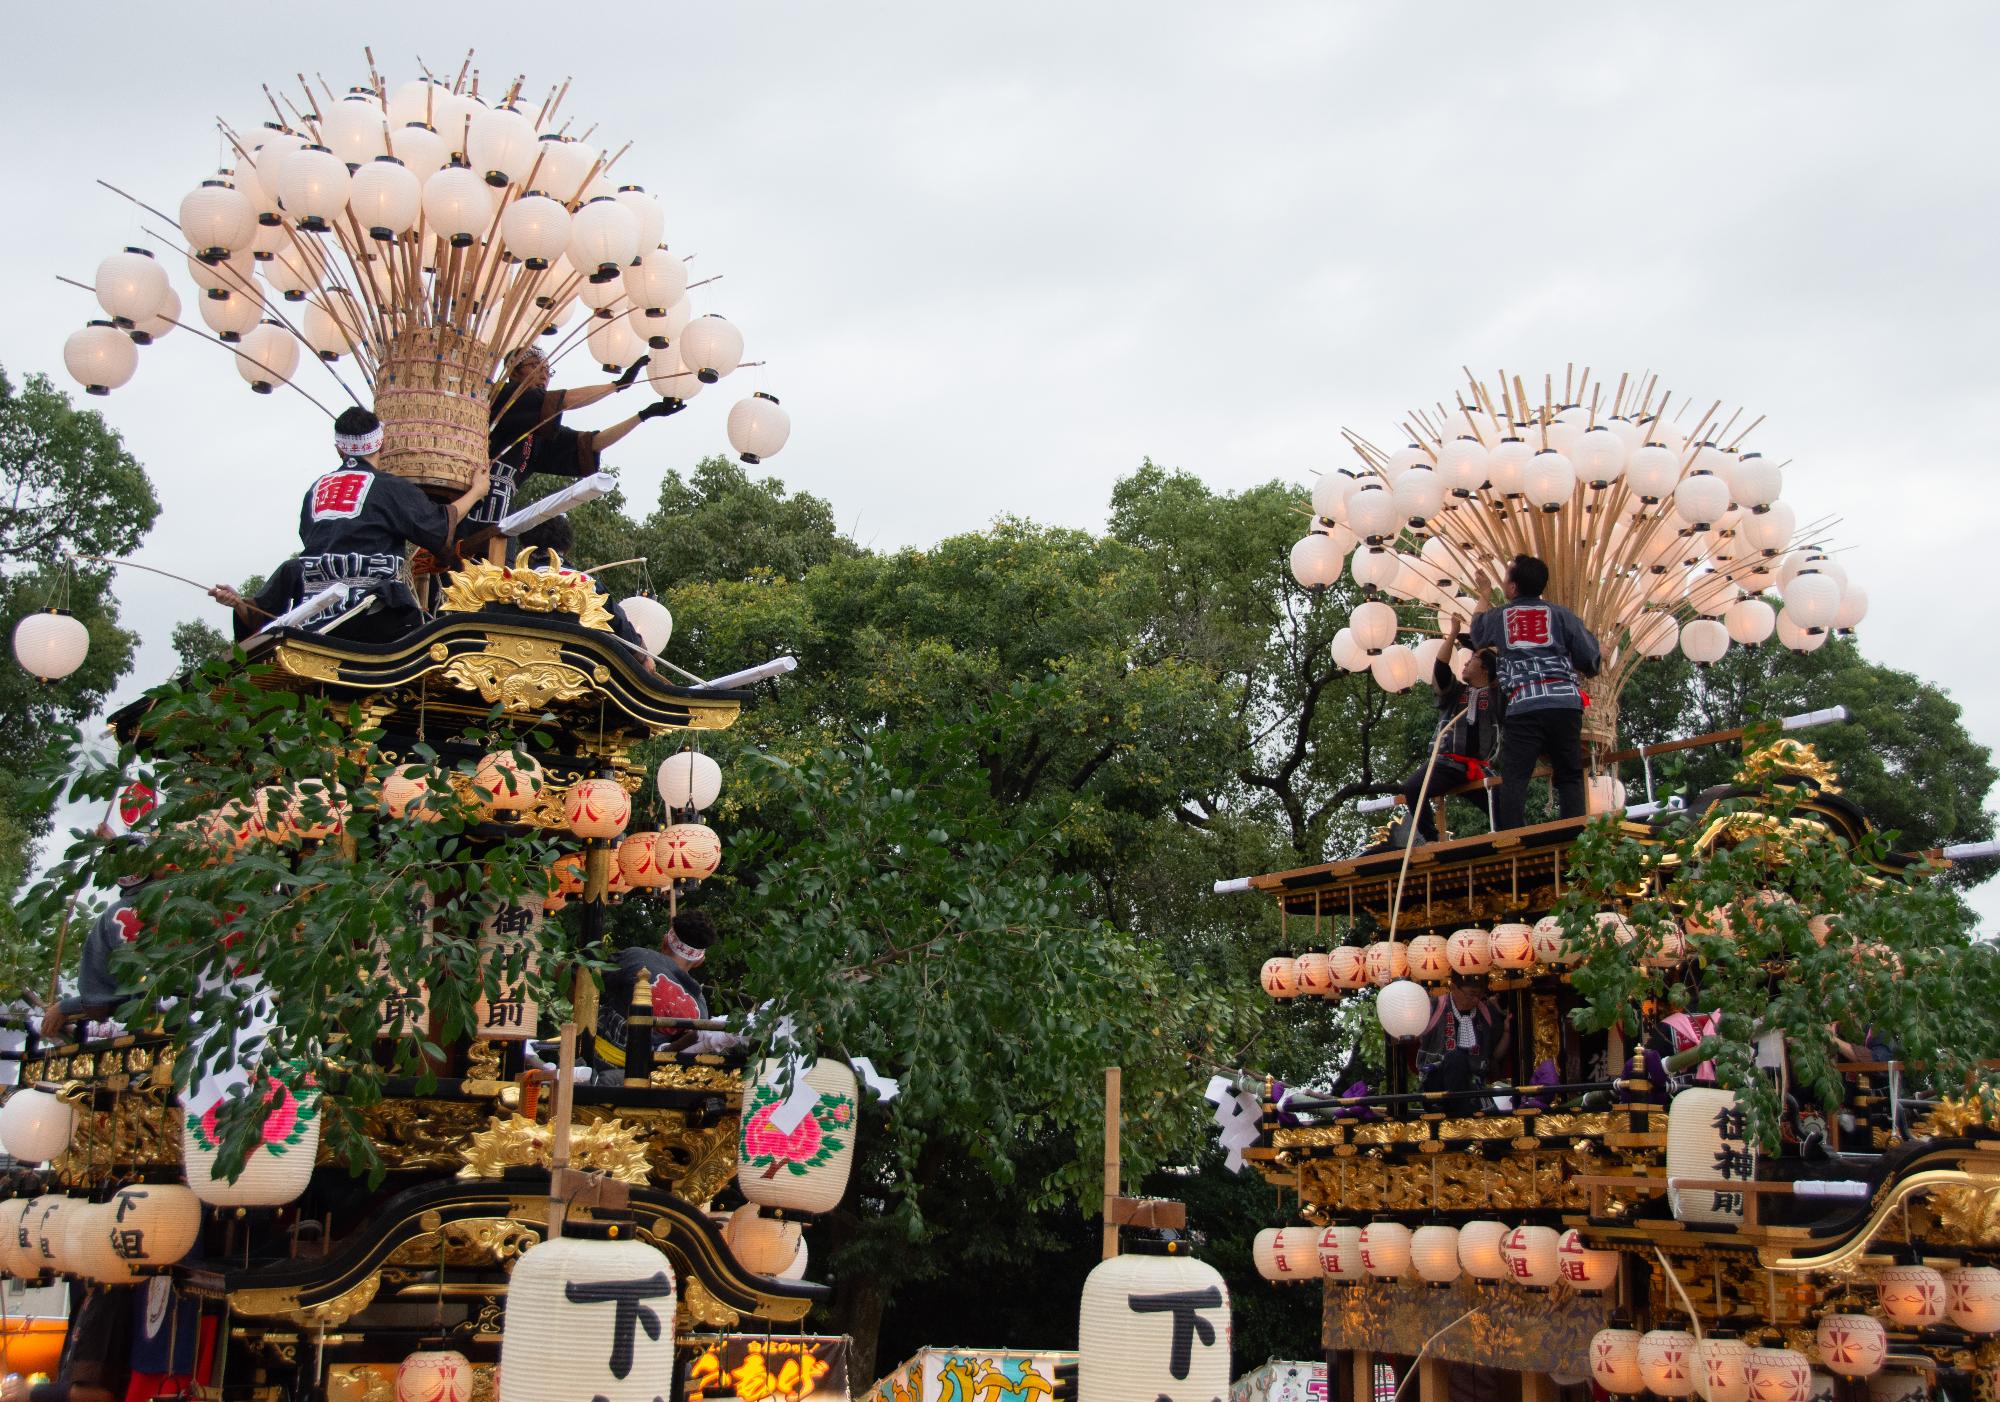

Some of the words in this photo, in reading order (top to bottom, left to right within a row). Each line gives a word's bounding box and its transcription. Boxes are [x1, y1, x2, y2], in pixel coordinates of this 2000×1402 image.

[109, 1191, 150, 1259] 下組
[1318, 1228, 1344, 1273] 上組
[1506, 1228, 1534, 1278] 上組
[1558, 1231, 1590, 1281] 上組
[564, 1270, 672, 1402] 下
[1127, 1285, 1223, 1402] 下
